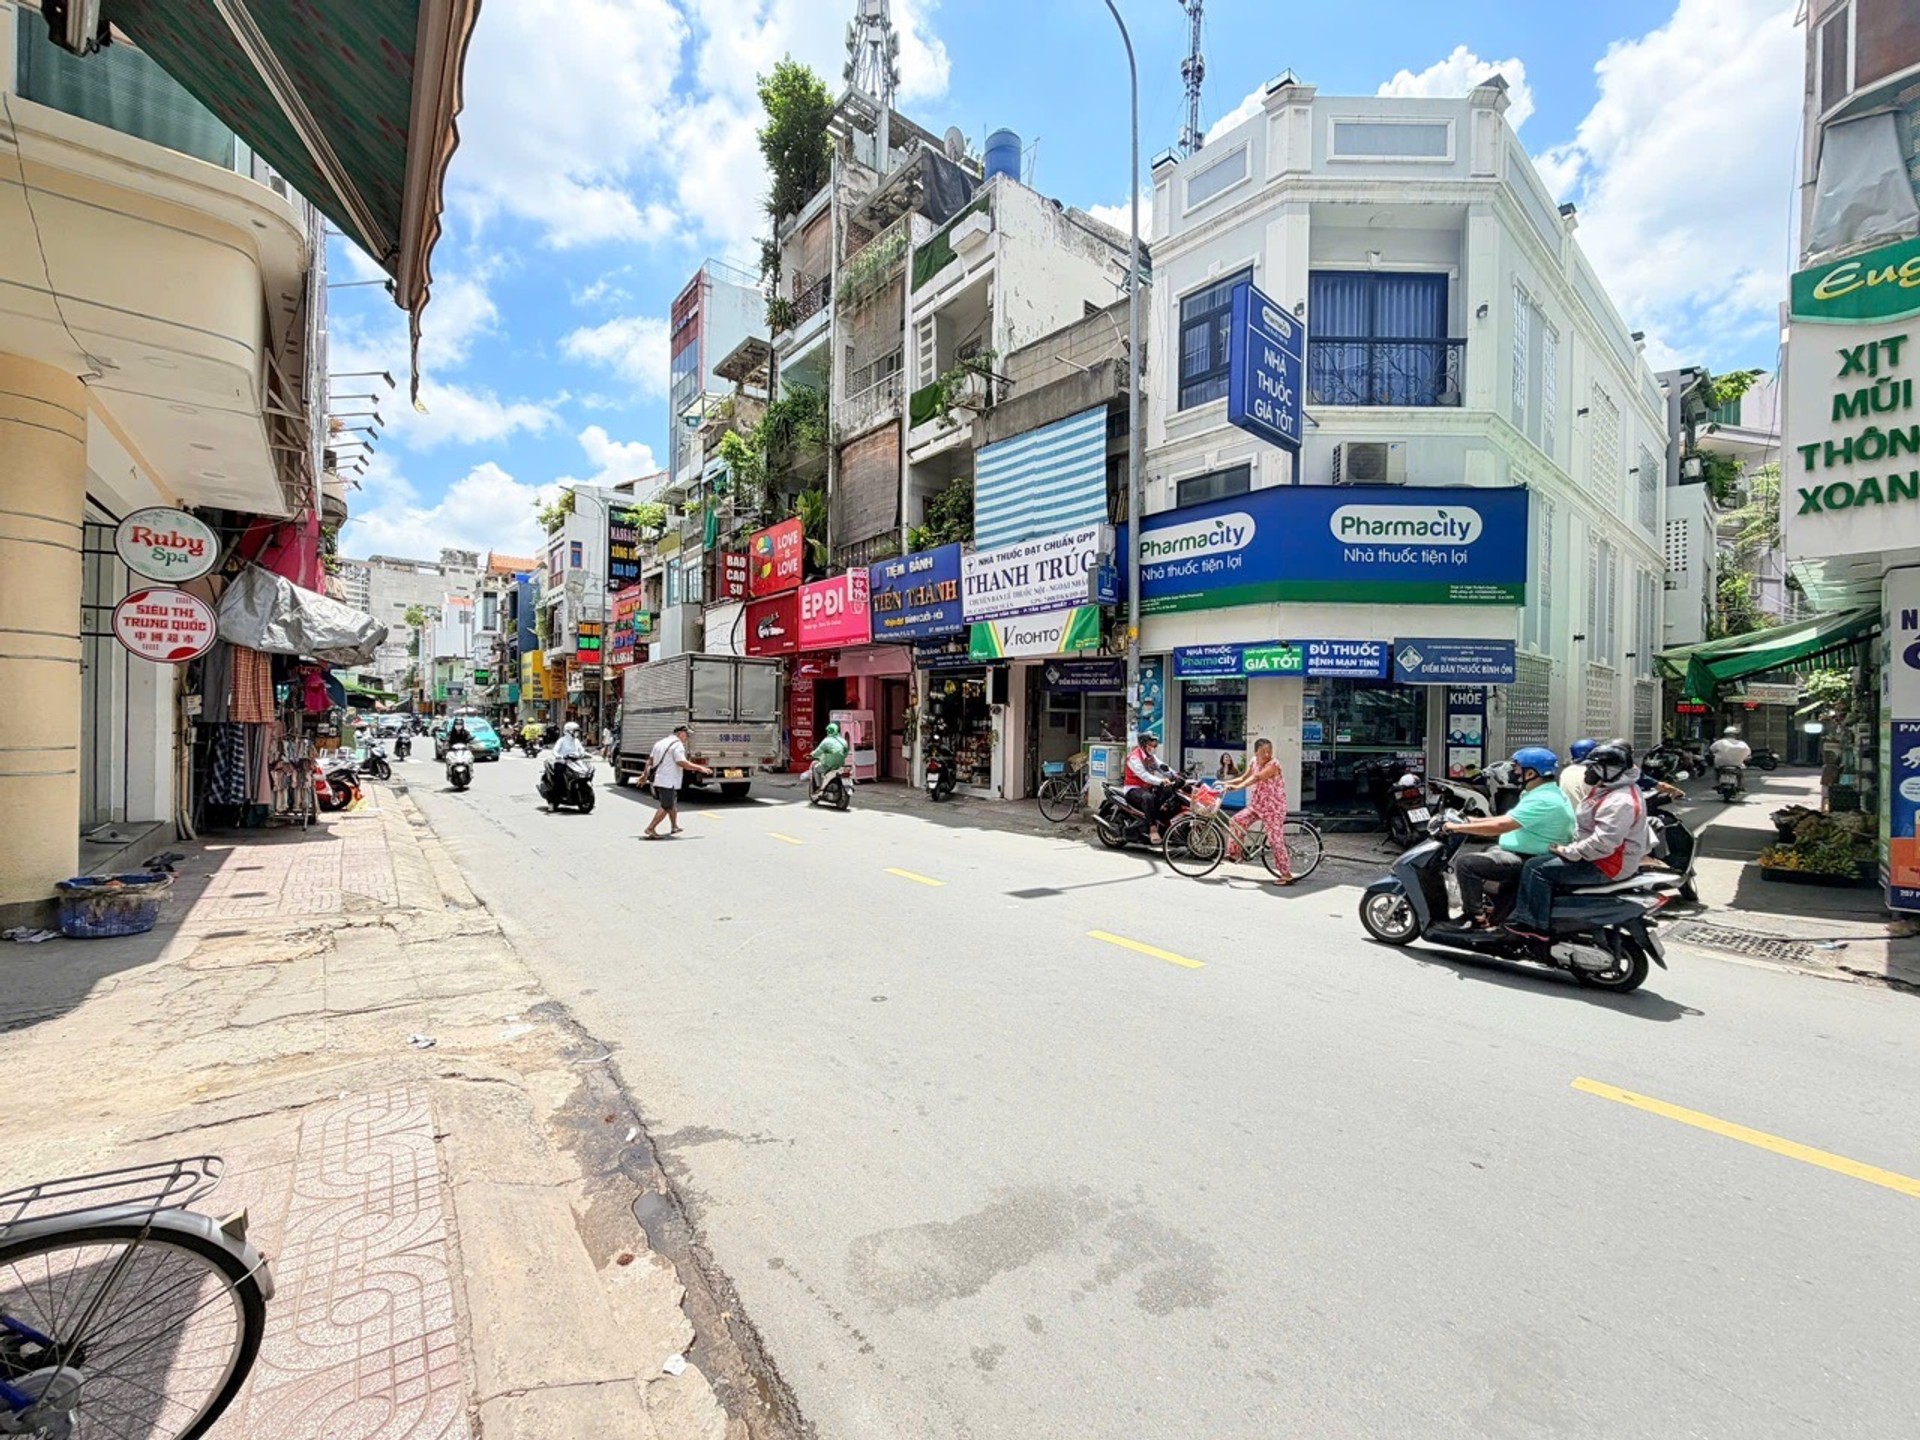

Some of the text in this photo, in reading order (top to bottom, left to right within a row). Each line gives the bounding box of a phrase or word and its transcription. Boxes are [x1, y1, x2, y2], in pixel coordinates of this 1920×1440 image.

[1264, 346, 1287, 377] NHÀ
[1837, 334, 1908, 378] XỊT
[1257, 369, 1293, 407] THUỐC
[1831, 376, 1913, 422] MŨI
[1254, 398, 1293, 434] GIÁ TỐT
[1341, 509, 1471, 541] Pharmacity
[131, 526, 204, 556] Ruby
[777, 530, 798, 550] LOVE
[978, 556, 994, 566] NHÀ
[996, 547, 1023, 561] THUỐC
[1024, 544, 1042, 556] ĐẠT
[1077, 531, 1096, 544] GPP
[1140, 520, 1245, 558] Pharmacity
[151, 546, 189, 566] Spa
[727, 555, 746, 568] BAO
[909, 556, 933, 573] BÁNH
[1344, 547, 1468, 566] Nhà thuốc tiện lợi
[726, 569, 746, 582] CAO
[777, 557, 798, 577] LOVE
[1142, 553, 1243, 582] Nhà thuốc tiện lợi
[730, 583, 743, 595] SU
[965, 564, 1030, 596] THANH
[873, 579, 958, 612] TIẾN THÀNH
[136, 603, 196, 619] SIÊU THỊ
[122, 616, 207, 632] TRUNG QUỐC
[1187, 646, 1232, 656] NHÀ THUỐC
[1309, 640, 1329, 655] ĐỦ
[1332, 641, 1380, 656] THUỐC
[1181, 654, 1237, 668] Pharmacity
[1244, 652, 1301, 671] GIÁ TỐT
[1308, 656, 1380, 668] BỆNH MẠN TÍNH
[1457, 662, 1481, 674] THUỐC
[1450, 689, 1482, 705] KHỎE
